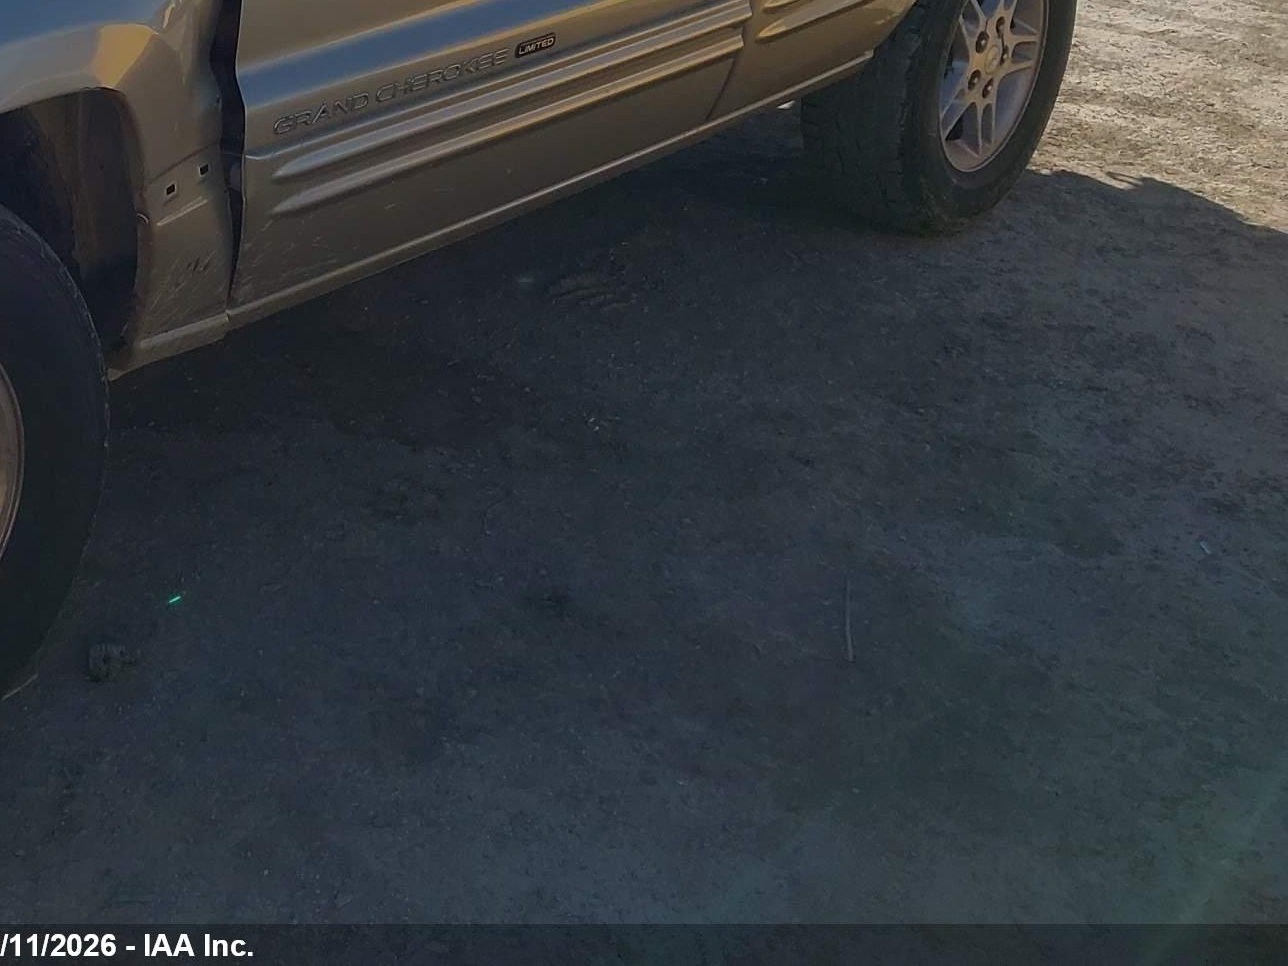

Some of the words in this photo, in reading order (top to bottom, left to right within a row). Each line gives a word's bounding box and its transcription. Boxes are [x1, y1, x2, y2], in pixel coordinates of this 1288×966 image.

[272, 92, 369, 135] GRAND
[376, 49, 508, 102] CHEROKEE
[518, 37, 555, 55] LIMITED
